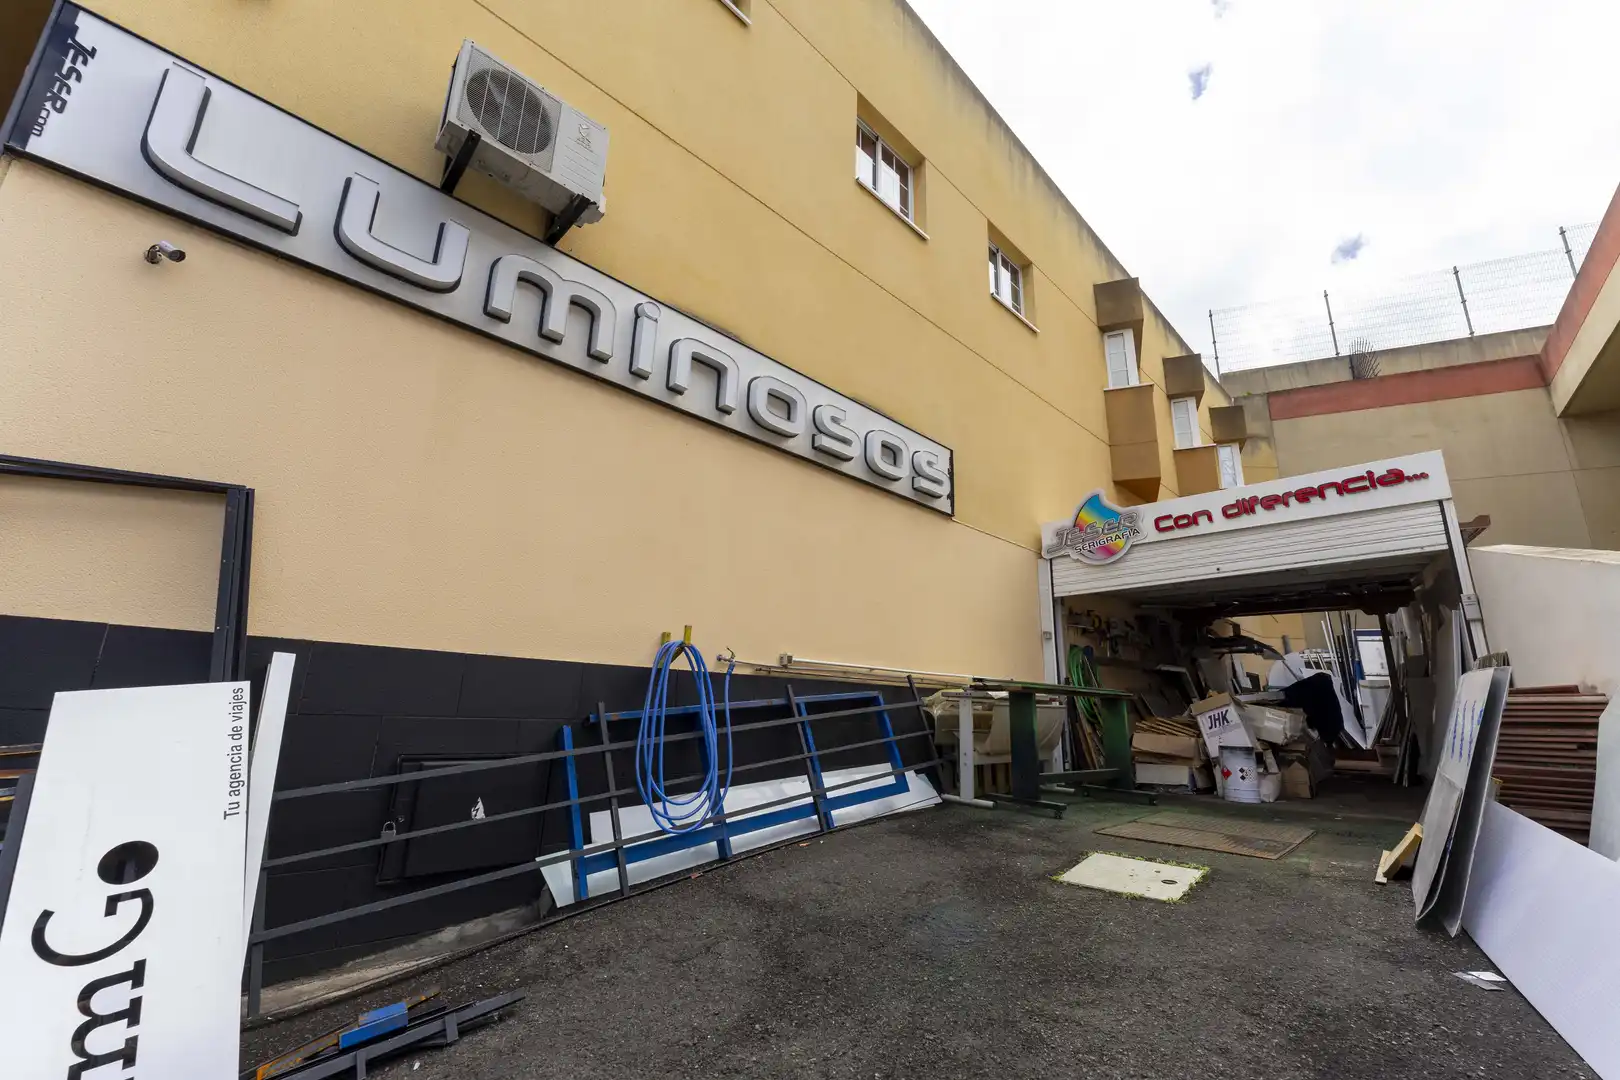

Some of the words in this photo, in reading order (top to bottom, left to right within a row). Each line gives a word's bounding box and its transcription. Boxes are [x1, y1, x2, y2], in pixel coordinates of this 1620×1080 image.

[140, 61, 952, 499] Luminosos
[1154, 509, 1213, 532] Con
[228, 687, 247, 722] viajes
[228, 725, 242, 740] de
[227, 744, 245, 797] agencia
[223, 800, 240, 820] Tu
